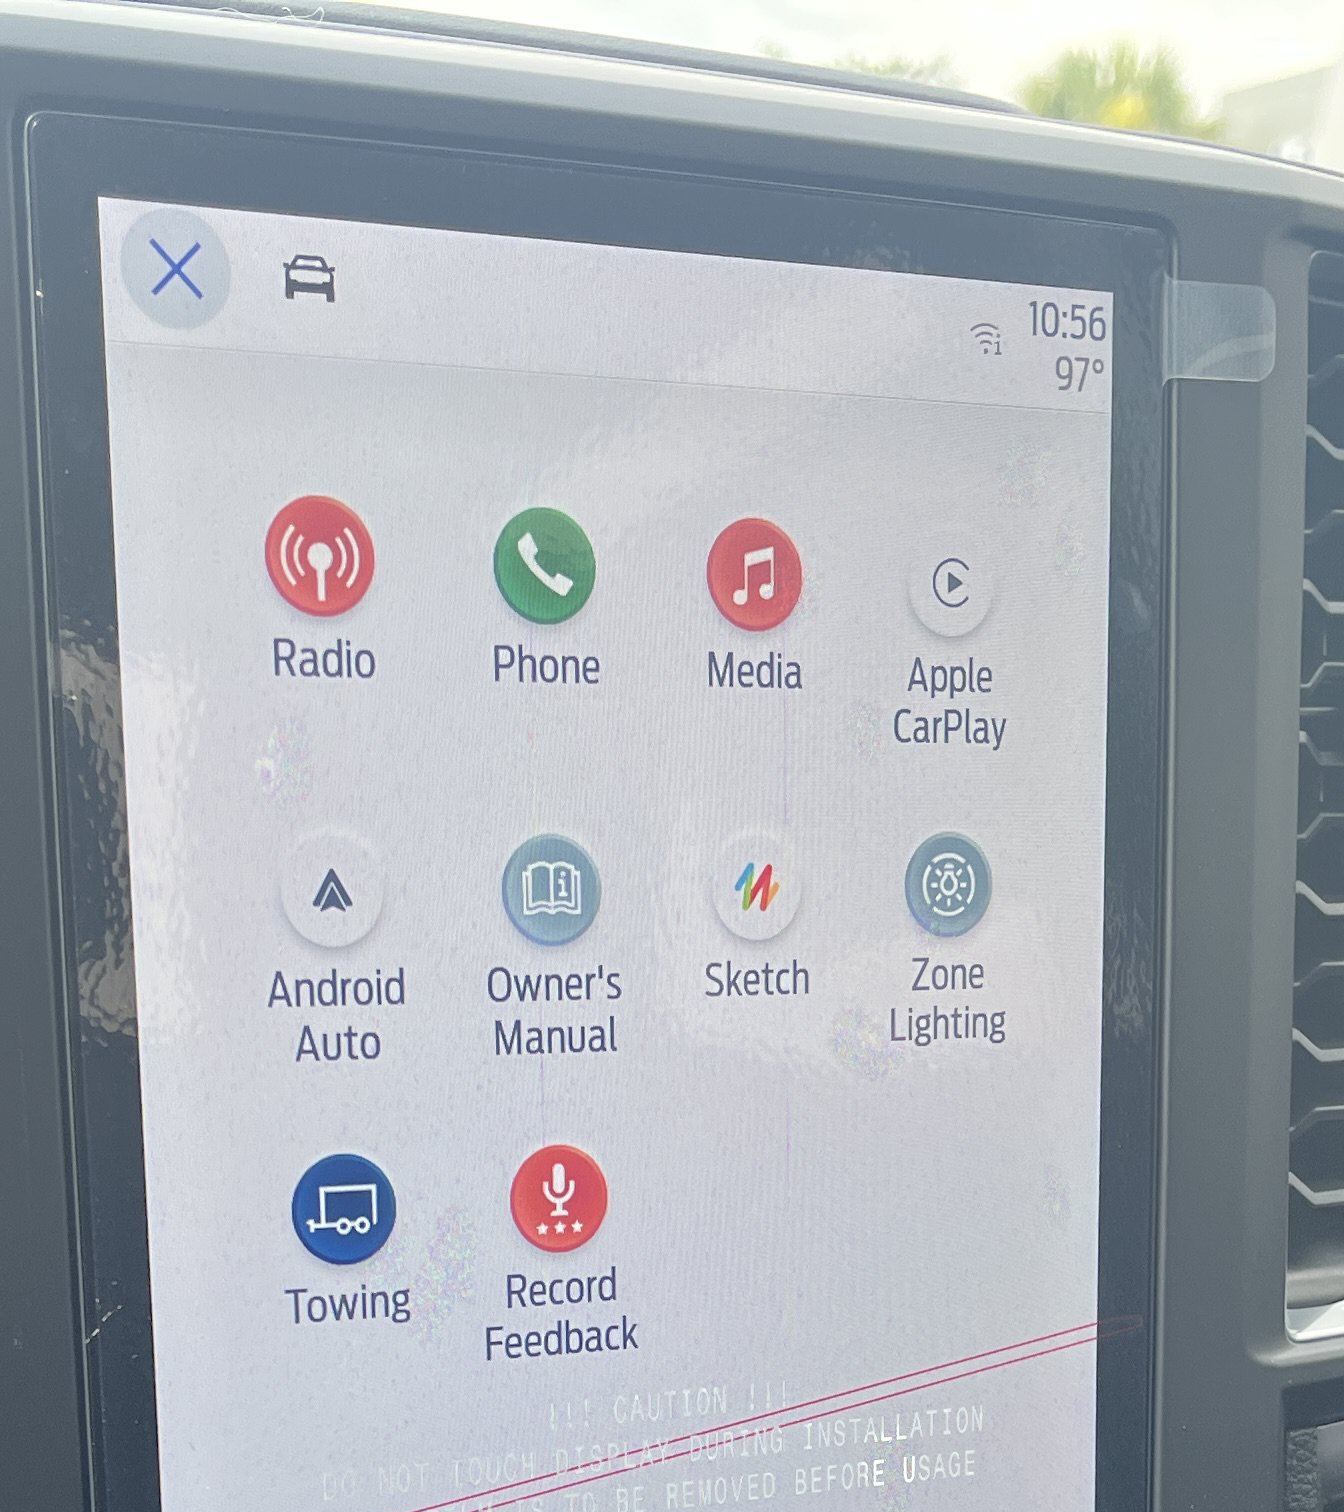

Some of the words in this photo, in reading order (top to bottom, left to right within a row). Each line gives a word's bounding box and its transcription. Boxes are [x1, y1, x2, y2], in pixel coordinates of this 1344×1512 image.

[1029, 300, 1106, 342] 10:56
[1055, 355, 1105, 393] 97°
[273, 637, 376, 679] Radio
[493, 643, 600, 685] Phone
[708, 651, 803, 689] Media
[907, 656, 993, 700] Apple
[893, 707, 1007, 751] CarPlay
[267, 967, 405, 1008] Android
[487, 964, 622, 1003] Owner's
[705, 959, 809, 997] Sketch
[911, 957, 984, 991] Zone
[295, 1025, 381, 1062] Auto
[494, 1015, 618, 1056] Manual
[890, 1005, 1006, 1047] Lighting
[284, 1284, 411, 1325] Towing
[506, 1265, 617, 1309] Record
[485, 1314, 639, 1361] Feedback
[613, 1384, 728, 1424] CAUTION
[378, 1463, 426, 1496] NOT
[455, 1452, 534, 1487] TOUCH
[556, 1438, 670, 1475] DISPLAY
[690, 1428, 783, 1462] DURING
[804, 1405, 983, 1451] INSTALLATION
[666, 1473, 775, 1510] REMOVED
[796, 1458, 884, 1495] BEFORE
[903, 1450, 975, 1484] USAGE
